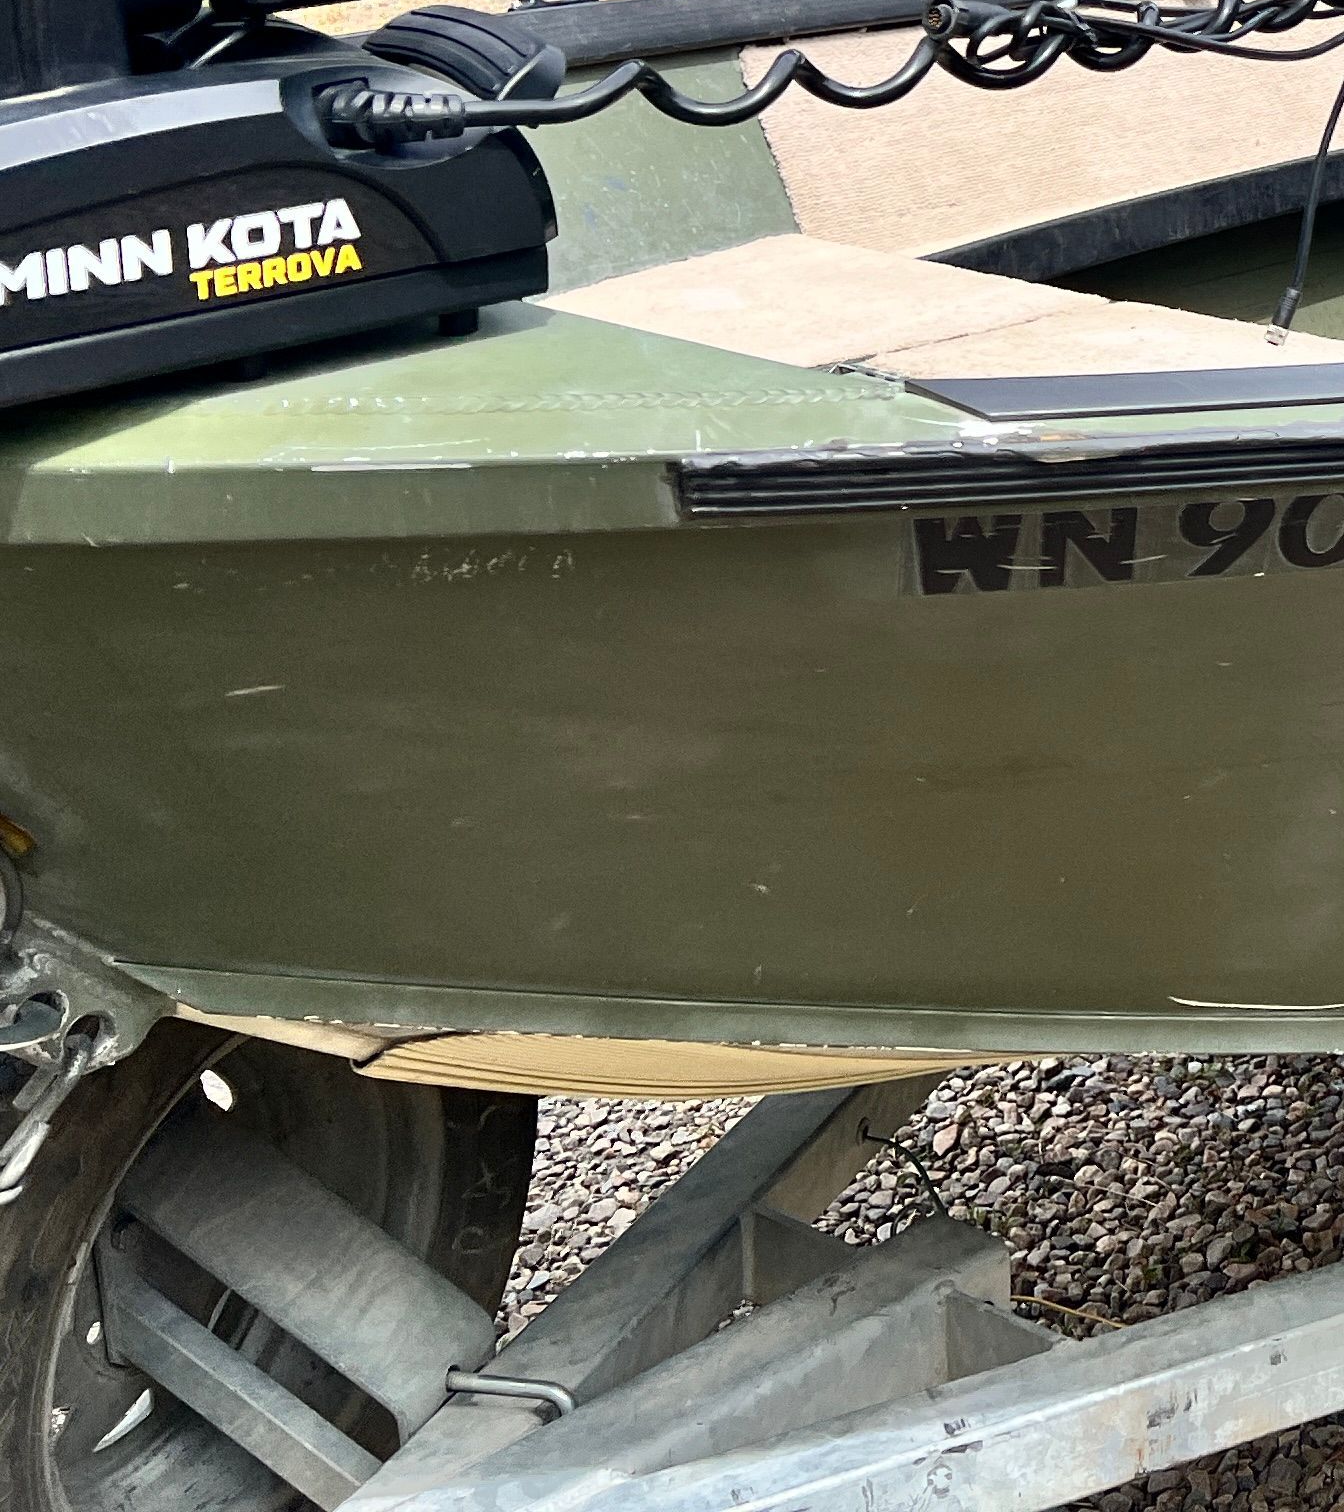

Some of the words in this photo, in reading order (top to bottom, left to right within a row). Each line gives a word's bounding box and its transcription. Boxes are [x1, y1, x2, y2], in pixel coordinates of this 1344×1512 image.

[0, 229, 174, 305] MINN
[187, 197, 362, 270] KOTA
[190, 244, 363, 301] TERROVA
